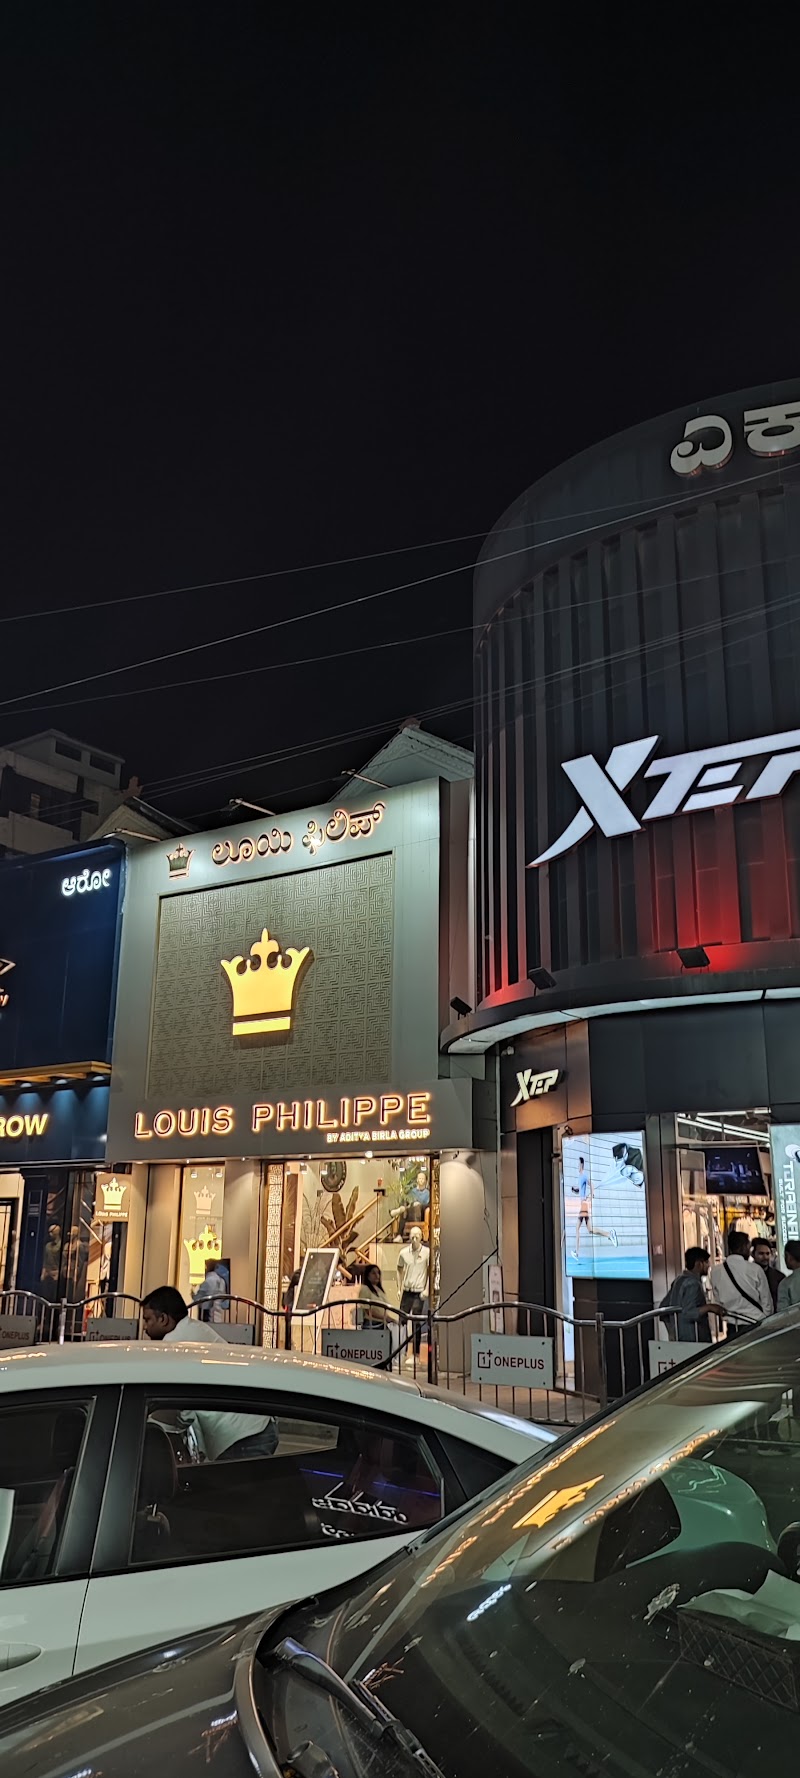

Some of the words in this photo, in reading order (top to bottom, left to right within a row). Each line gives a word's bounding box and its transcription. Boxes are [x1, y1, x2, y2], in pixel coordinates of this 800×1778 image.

[211, 827, 294, 866] ಲೂಯಿ
[61, 867, 112, 896] ಆರೋ
[510, 1068, 559, 1107] XTEP
[134, 1105, 234, 1139] LOUIS
[252, 1091, 431, 1132] PHILIPPE
[326, 1132, 339, 1143] BY
[340, 1131, 371, 1143] ADITYA
[371, 1130, 398, 1141] BIRLA
[399, 1128, 430, 1140] GROUP
[340, 1348, 383, 1361] ONEPLUS
[494, 1356, 545, 1370] ONEPLUS
